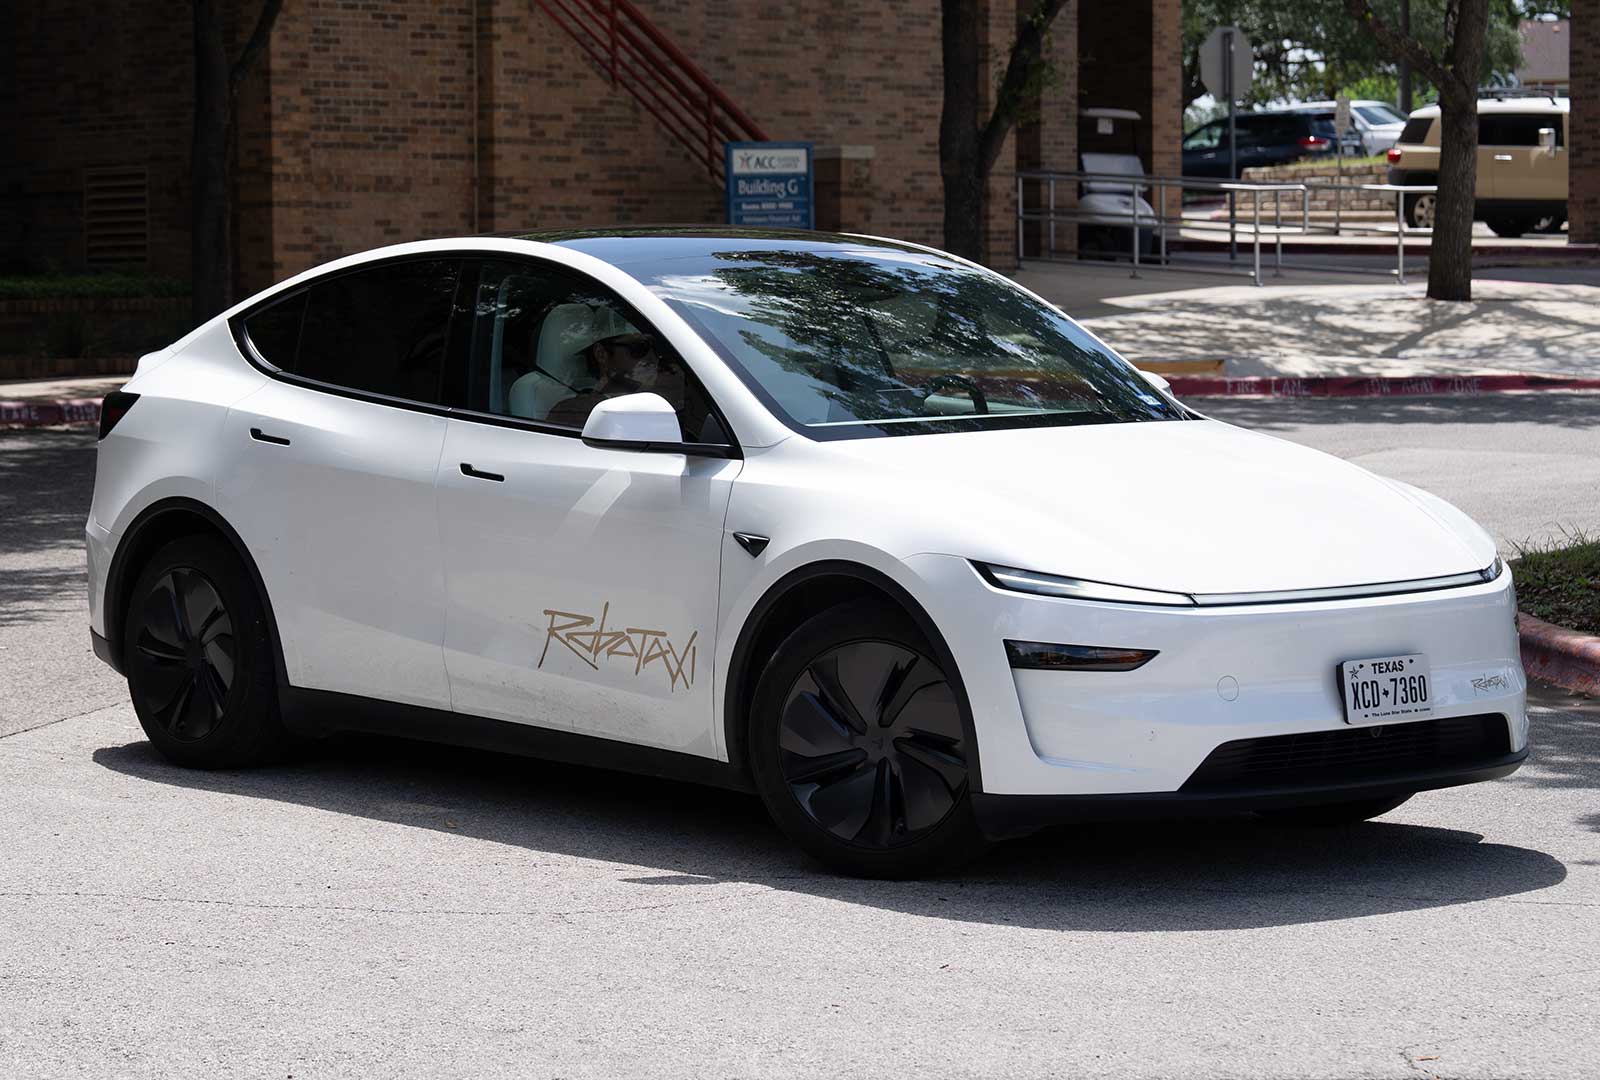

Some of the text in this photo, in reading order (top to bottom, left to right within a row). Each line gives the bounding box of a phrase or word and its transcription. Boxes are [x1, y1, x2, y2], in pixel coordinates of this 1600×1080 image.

[754, 156, 777, 169] ACC
[738, 179, 799, 198] Building G
[1226, 380, 1257, 393] FIRE
[1271, 380, 1312, 395] LANE
[1371, 660, 1404, 674] TEXAS
